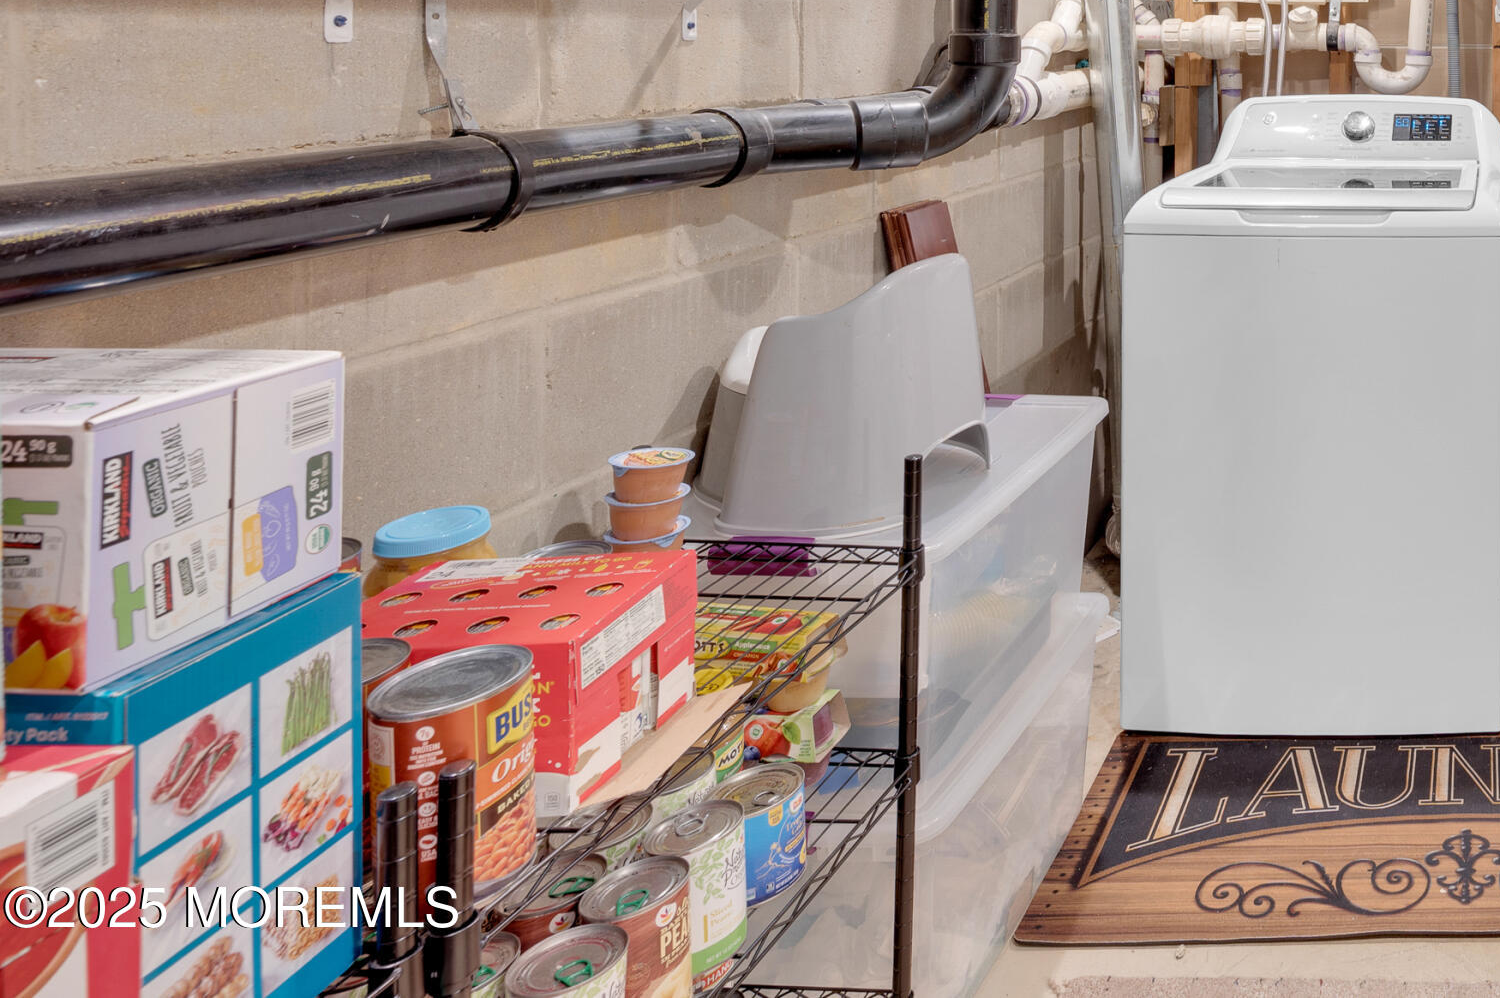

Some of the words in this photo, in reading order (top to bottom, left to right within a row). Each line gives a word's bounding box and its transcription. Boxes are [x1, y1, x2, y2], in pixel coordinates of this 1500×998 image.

[28, 439, 46, 451] 90
[160, 422, 188, 483] VEGETABLE
[187, 447, 208, 489] POUCHES
[144, 461, 167, 516] ORGANIC
[170, 482, 191, 494] &
[309, 478, 320, 492] 90
[101, 457, 123, 545] KIRKLAND
[170, 493, 195, 528] FRUIT
[309, 488, 329, 518] 24
[554, 558, 593, 567] MILK
[153, 562, 167, 618] KIRKLAND
[26, 726, 69, 743] Pack
[411, 742, 441, 755] PROTEIN
[497, 778, 531, 814] BAKED
[421, 848, 437, 860] USA
